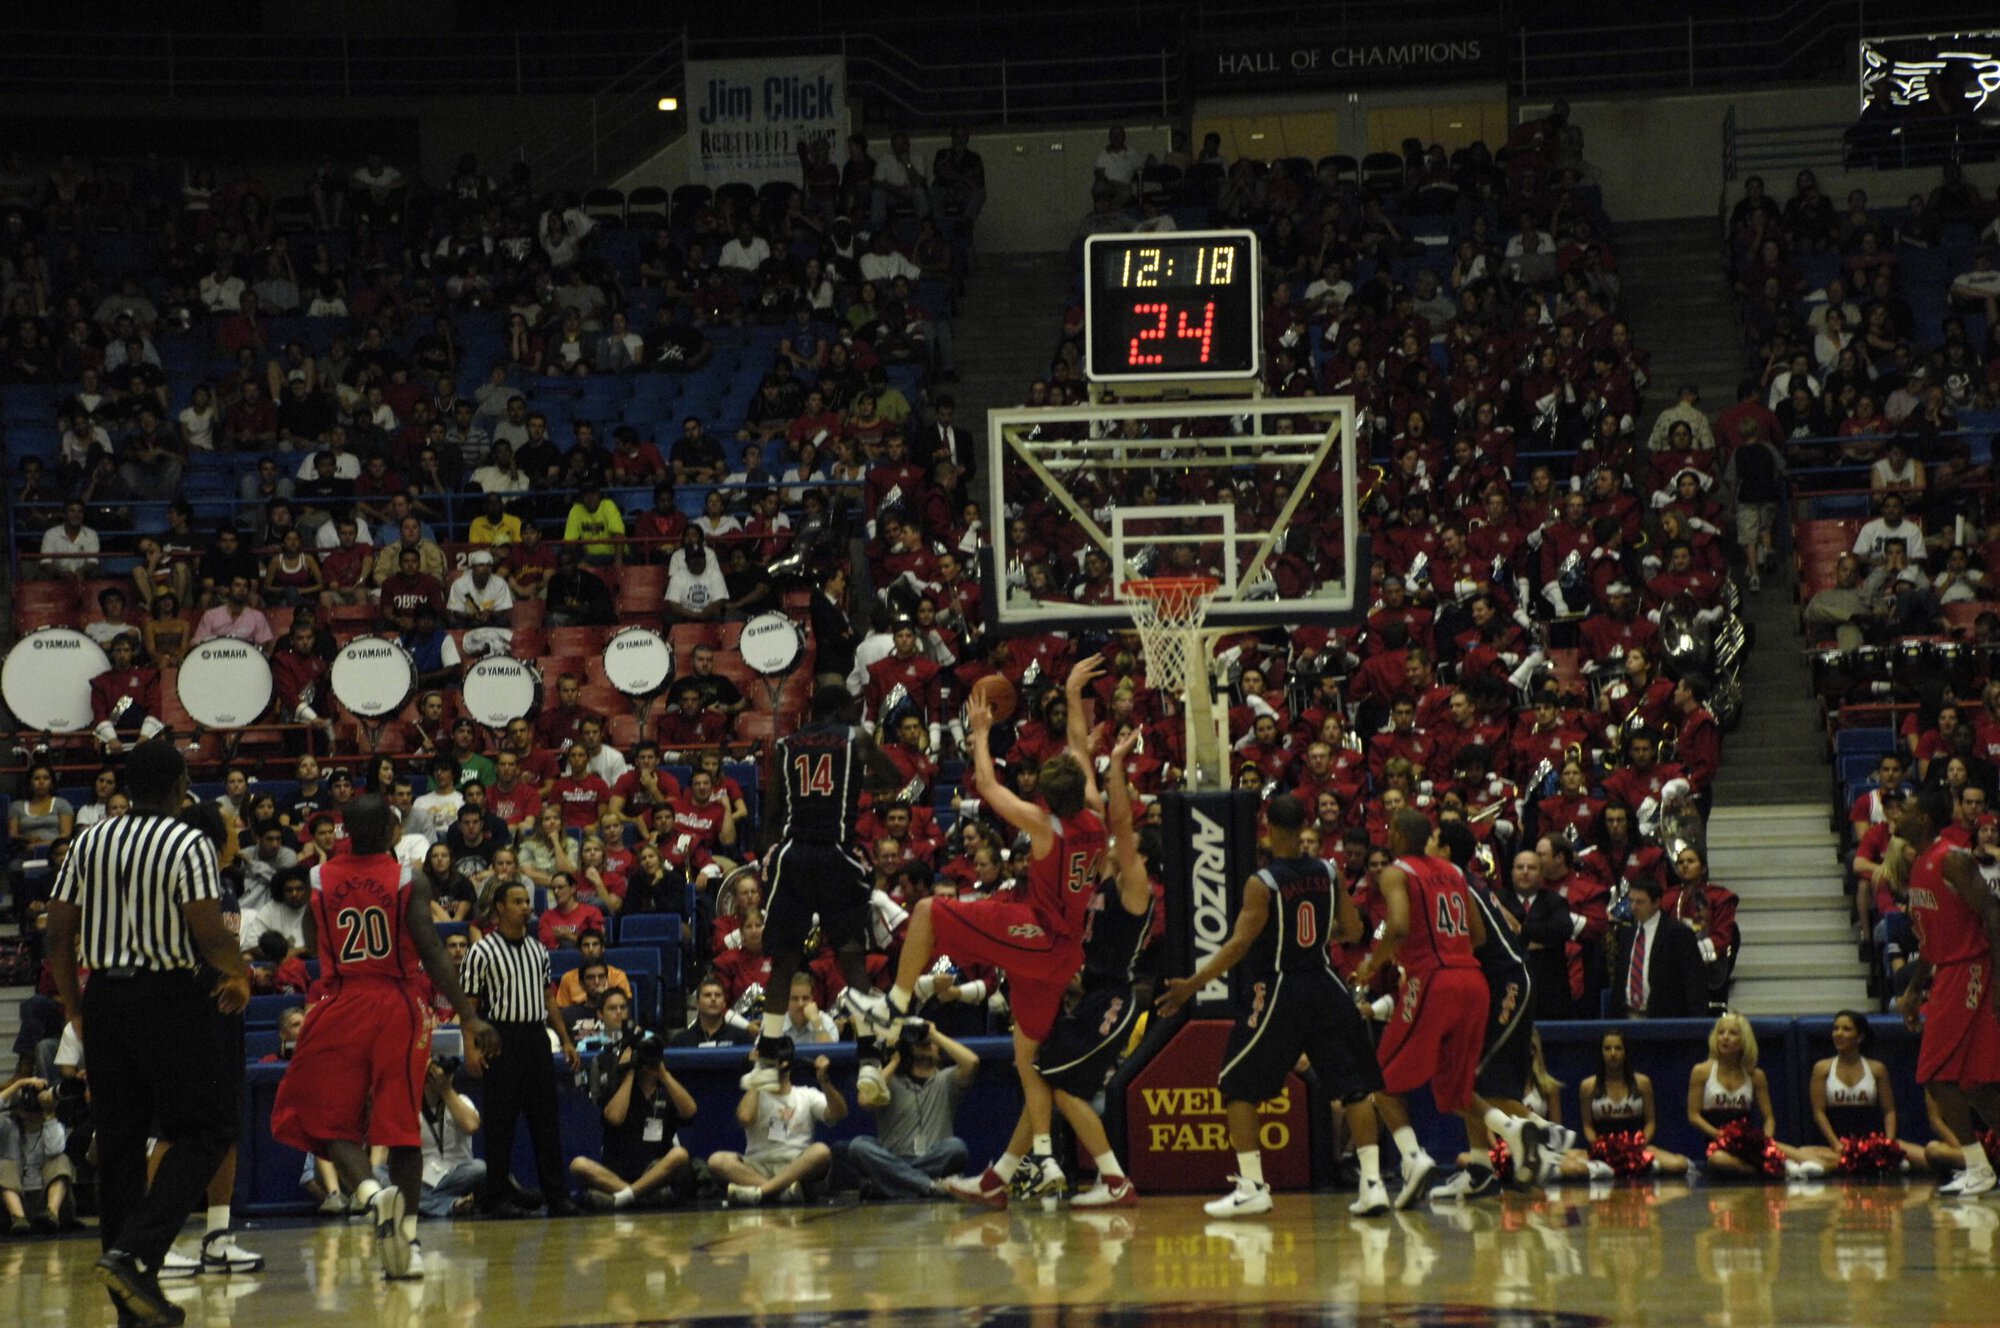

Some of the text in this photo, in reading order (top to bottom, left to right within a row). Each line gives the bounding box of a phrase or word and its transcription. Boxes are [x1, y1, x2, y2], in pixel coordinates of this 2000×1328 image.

[1218, 40, 1481, 75] HALL OF CHAMPIONS
[700, 76, 834, 124] Jim Click
[1122, 246, 1234, 288] 12:18
[1128, 301, 1216, 366] 24
[45, 640, 80, 649] YAMAHA
[625, 638, 653, 650] YAMAHA
[756, 621, 784, 635] YAMAHA
[212, 649, 248, 660] YAMAHA
[357, 648, 392, 659] YAMAHA
[487, 666, 521, 677] YAMAHA
[794, 753, 834, 797] 14
[1296, 901, 1317, 948] 0
[1436, 892, 1469, 938] 42
[337, 906, 392, 963] 20
[1141, 1086, 1291, 1116] WELS
[1148, 1121, 1290, 1152] FARO
